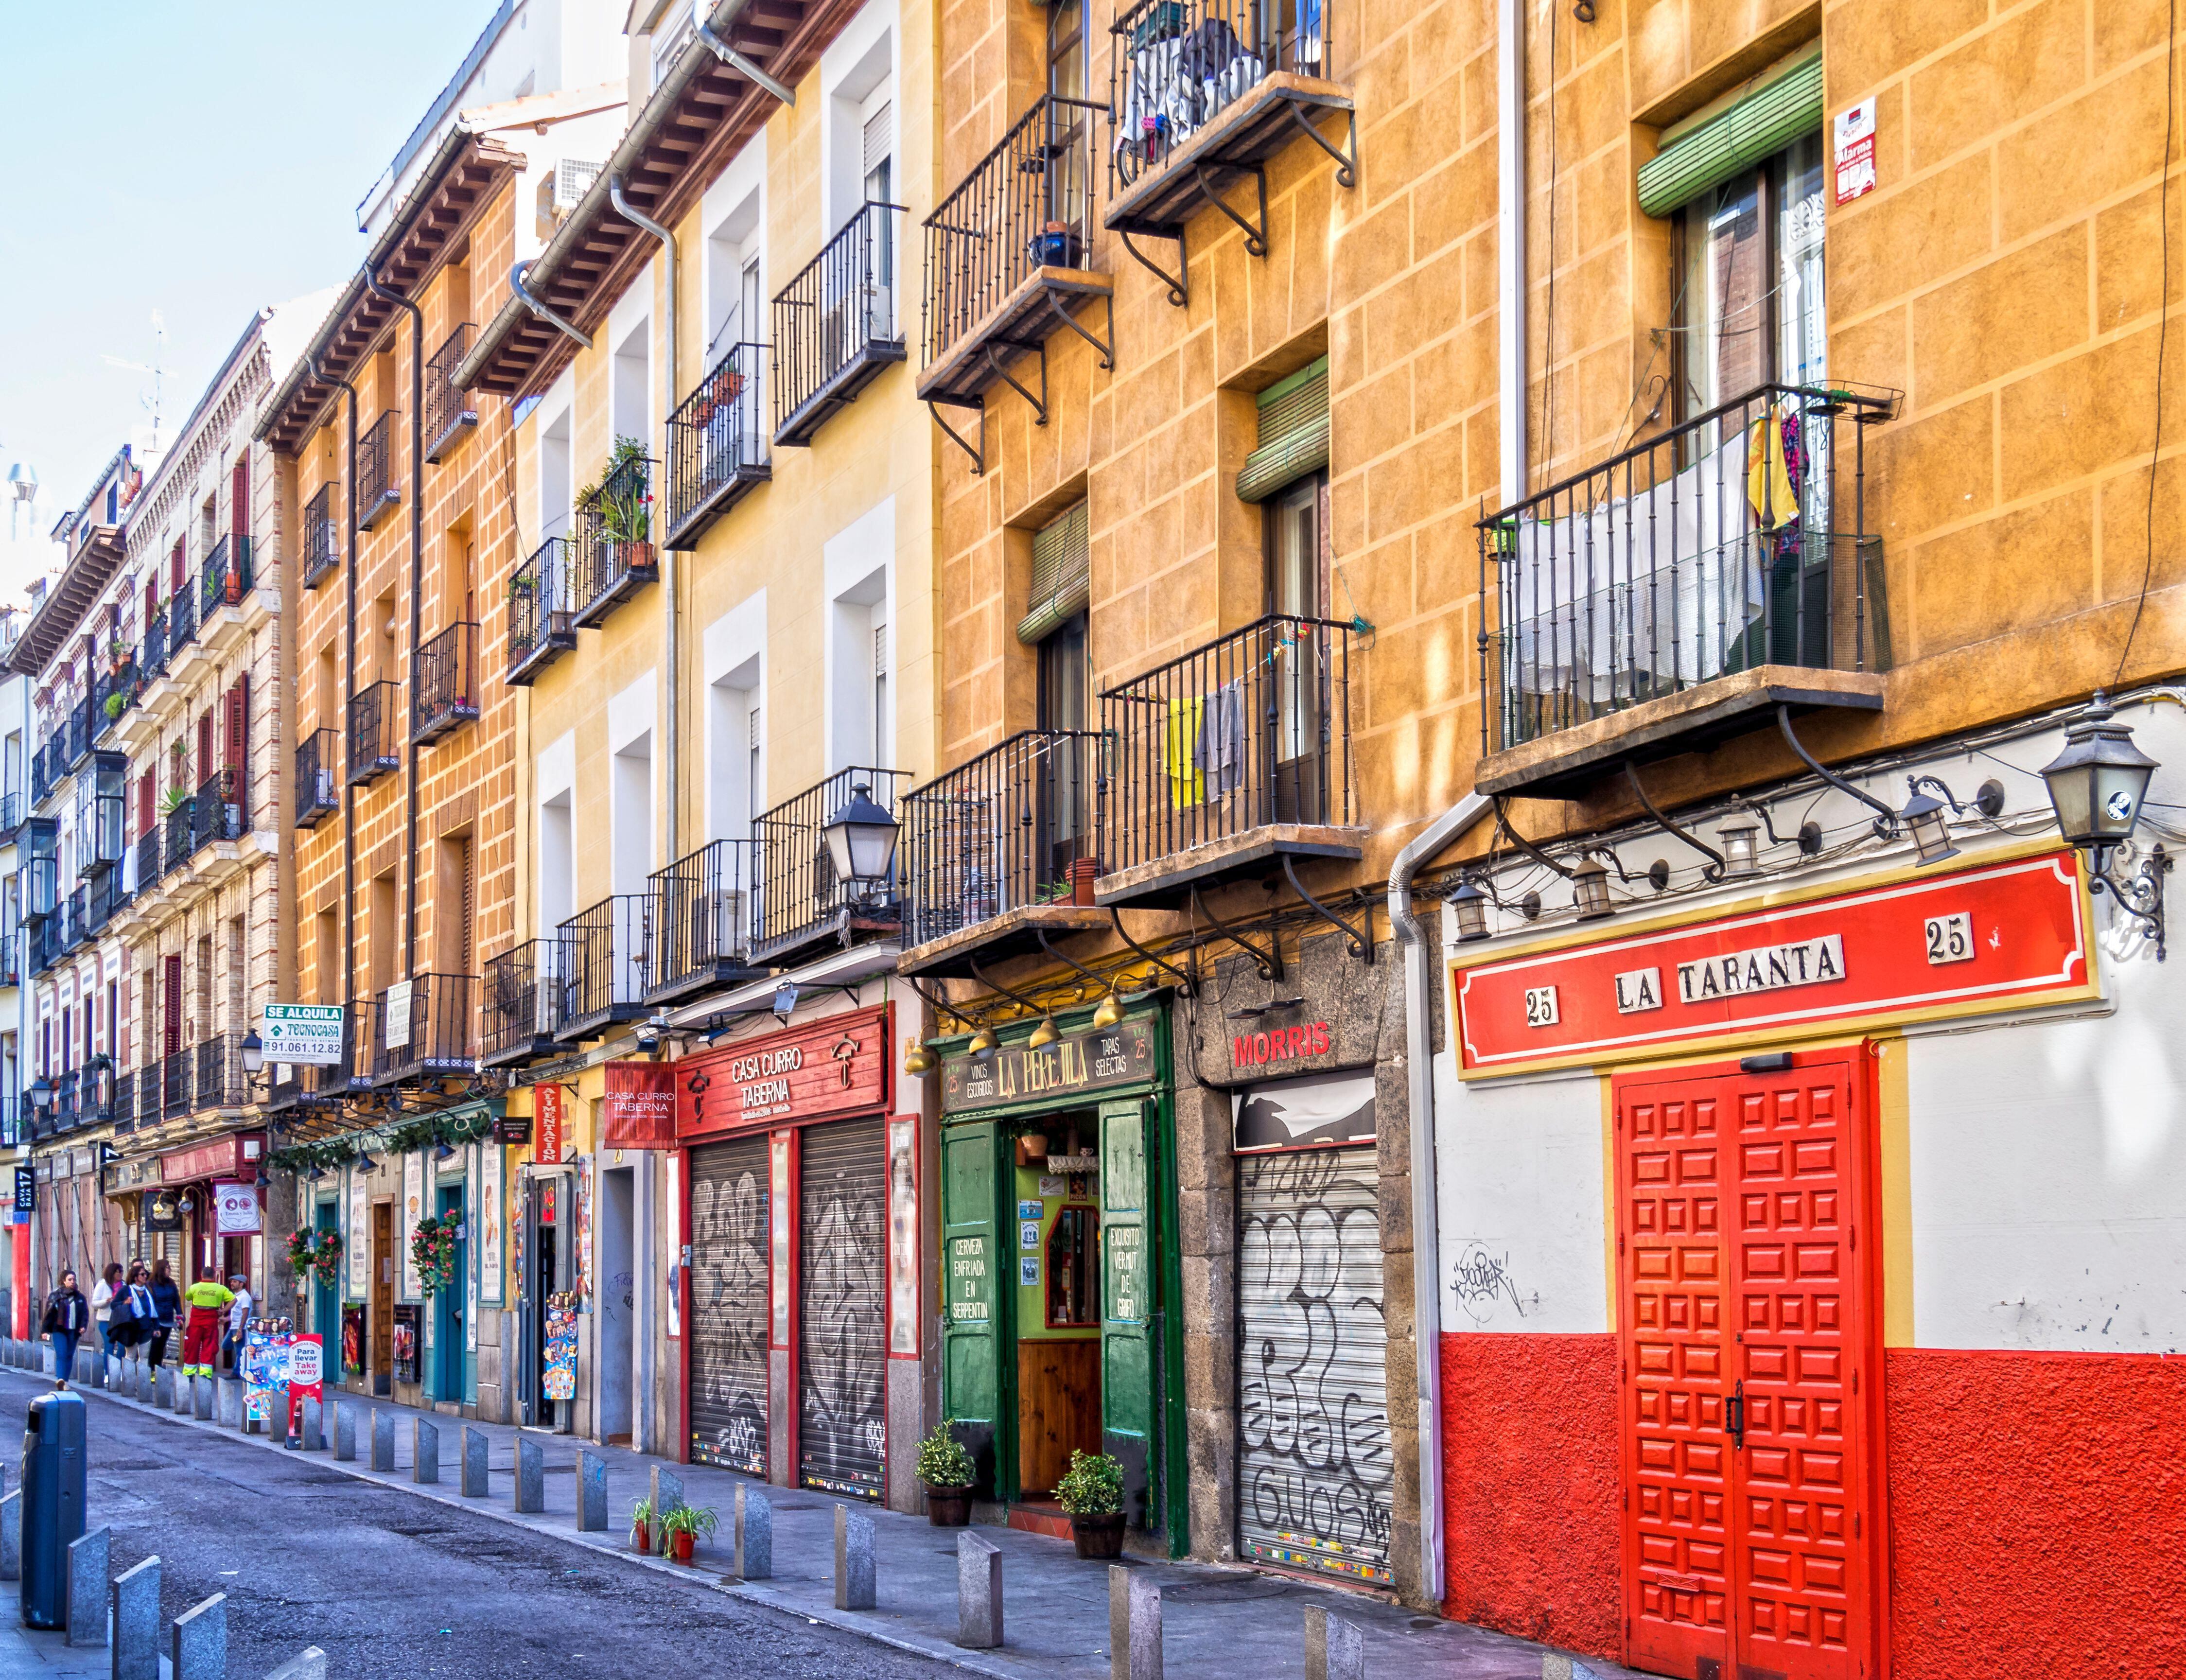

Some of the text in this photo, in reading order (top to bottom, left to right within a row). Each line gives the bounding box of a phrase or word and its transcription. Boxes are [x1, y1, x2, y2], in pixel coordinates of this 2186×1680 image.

[1837, 139, 1872, 163] Alarma
[1927, 917, 1965, 961] 25
[1615, 940, 1837, 1010] LA TARANTA
[268, 1007, 339, 1019] SE ALQUILA
[1527, 990, 1552, 1023] 25
[287, 1024, 339, 1037] TECNOCASA
[271, 1042, 340, 1053] 91.061.12.82
[1101, 1036, 1119, 1057] TAPAS
[1135, 1038, 1146, 1059] 25
[1234, 1021, 1329, 1068] MORRIS
[732, 1047, 802, 1083] CASA CURRO
[971, 1063, 988, 1080] VINOS
[998, 1040, 1088, 1099] LA PEREJILA
[1095, 1055, 1127, 1077] SELECTAS
[740, 1079, 790, 1108] TABERNA
[948, 1075, 958, 1094] 25
[966, 1079, 993, 1099] ESCOGIDOS
[612, 1102, 668, 1112] TABERNA
[542, 1087, 556, 1161] ALIMENTACION
[19, 1171, 32, 1187] 17
[1110, 1228, 1139, 1246] EXQUISITO
[956, 1238, 984, 1256] CERVEZA
[954, 1260, 986, 1277] ENFRIADA
[1114, 1251, 1137, 1270] VERMUT
[965, 1280, 976, 1297] EN
[1121, 1275, 1130, 1293] DE
[953, 1302, 988, 1319] SERPENTIN
[1118, 1298, 1134, 1318] GRIFO
